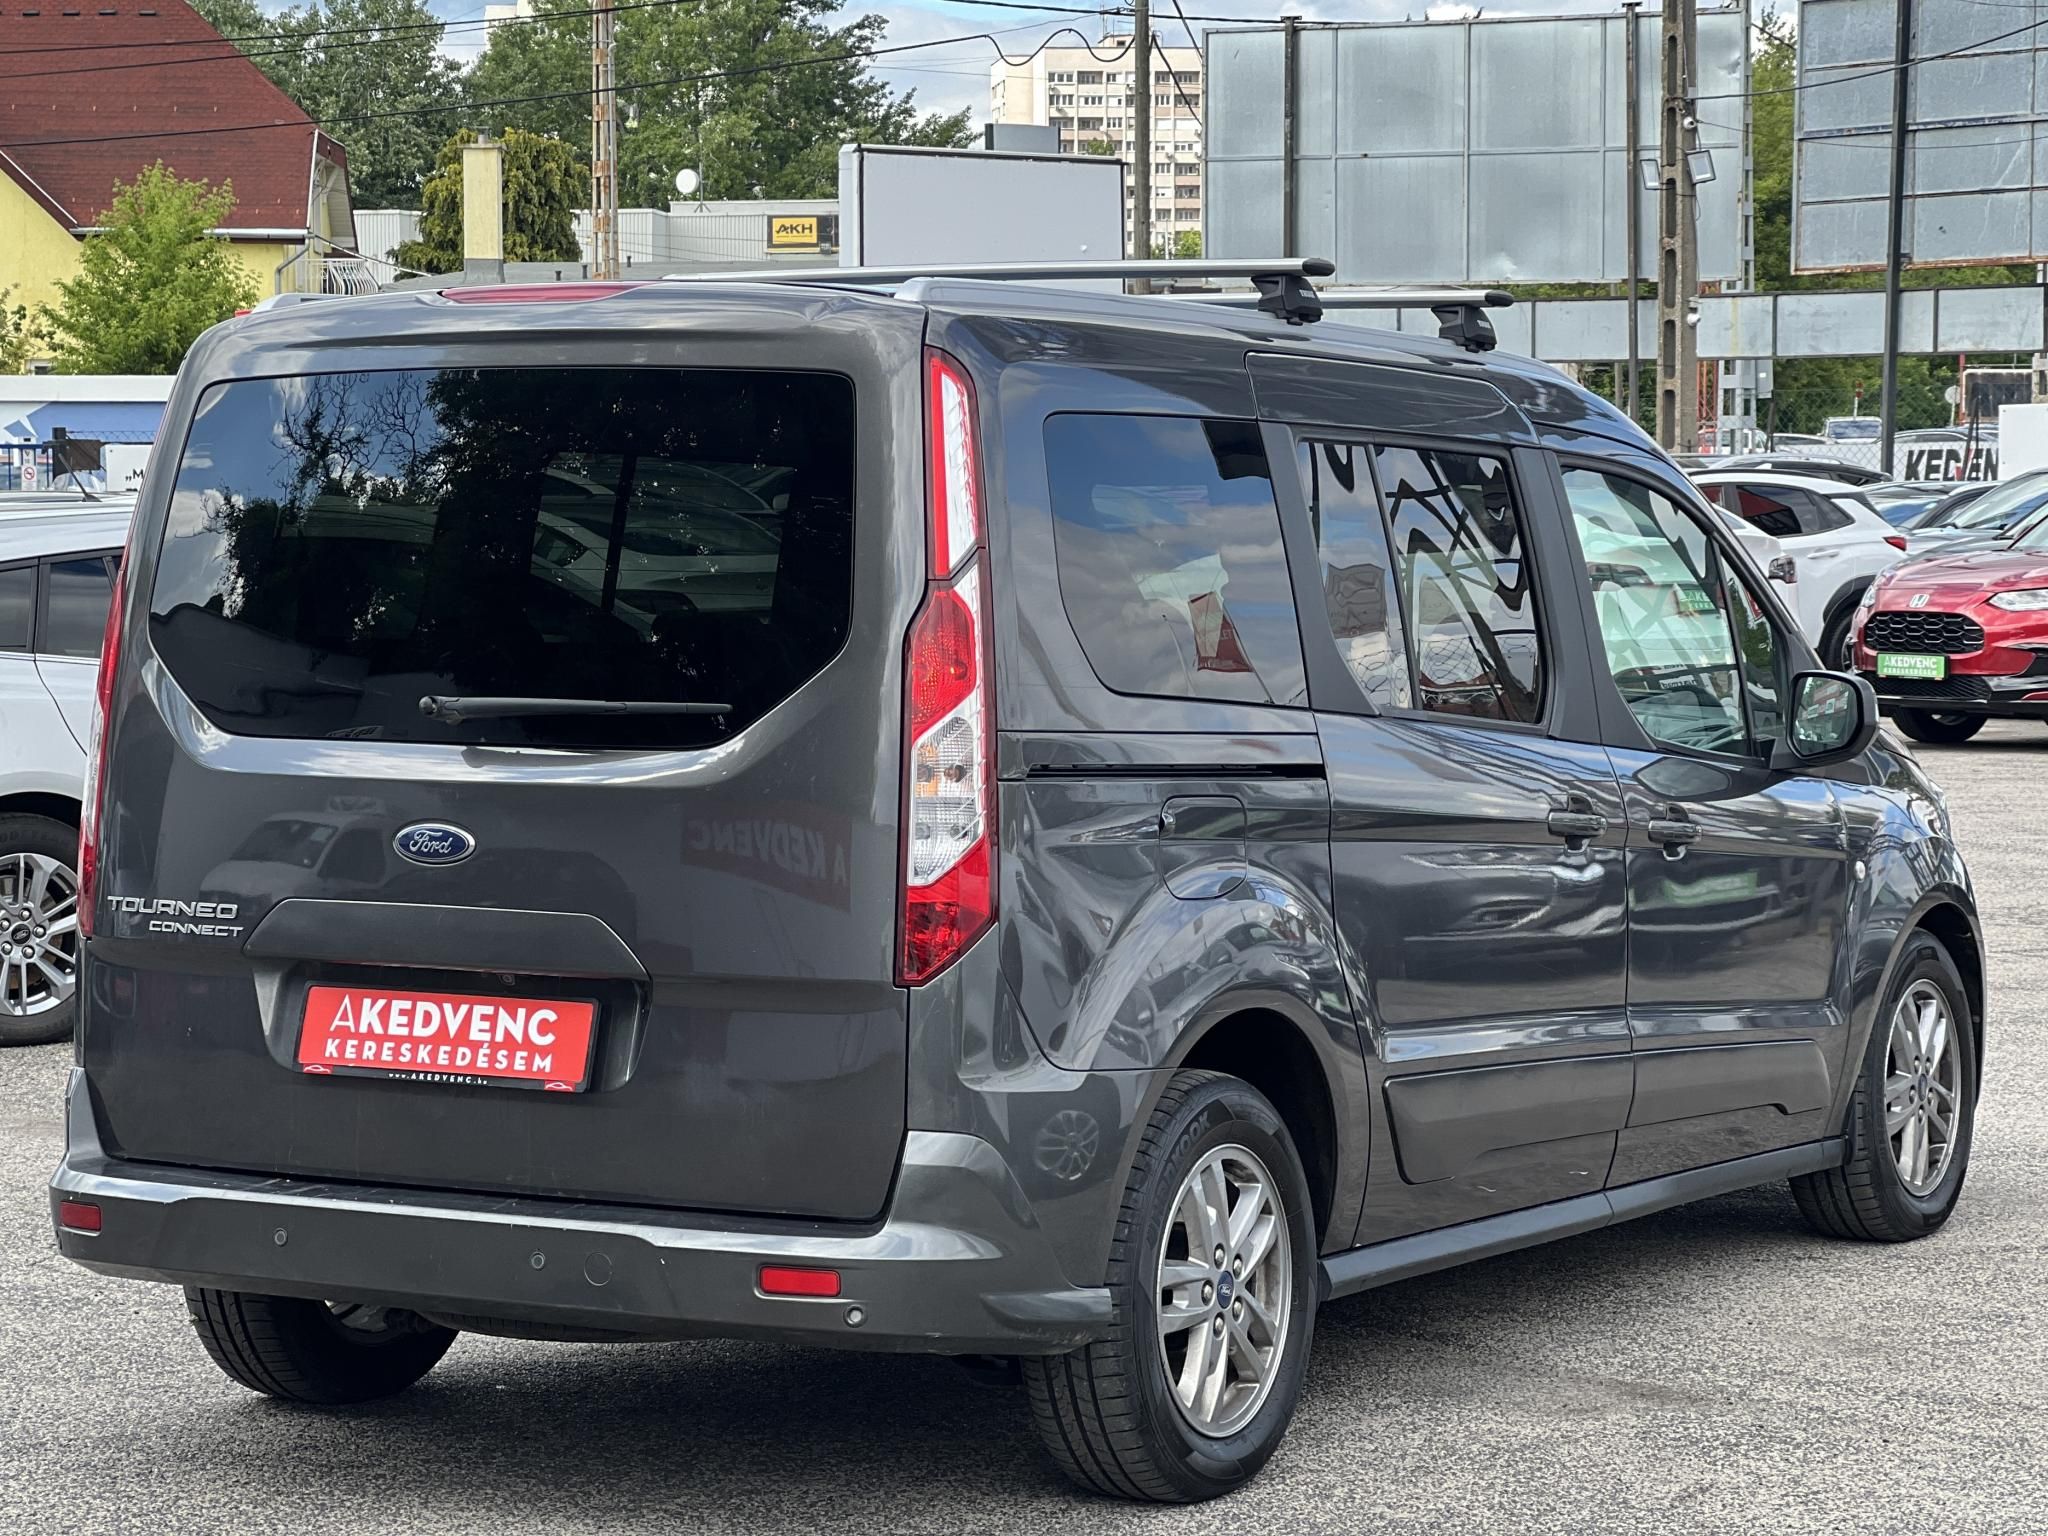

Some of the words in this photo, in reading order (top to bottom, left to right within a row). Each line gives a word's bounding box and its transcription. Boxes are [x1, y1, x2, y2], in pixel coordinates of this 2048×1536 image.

[776, 223, 813, 234] AKH
[409, 829, 454, 854] Ford
[107, 895, 239, 919] TOURNEO
[148, 920, 244, 937] CONNECT
[329, 993, 559, 1046] AKEDVENC
[324, 1038, 553, 1073] KERESKEDÉSEM
